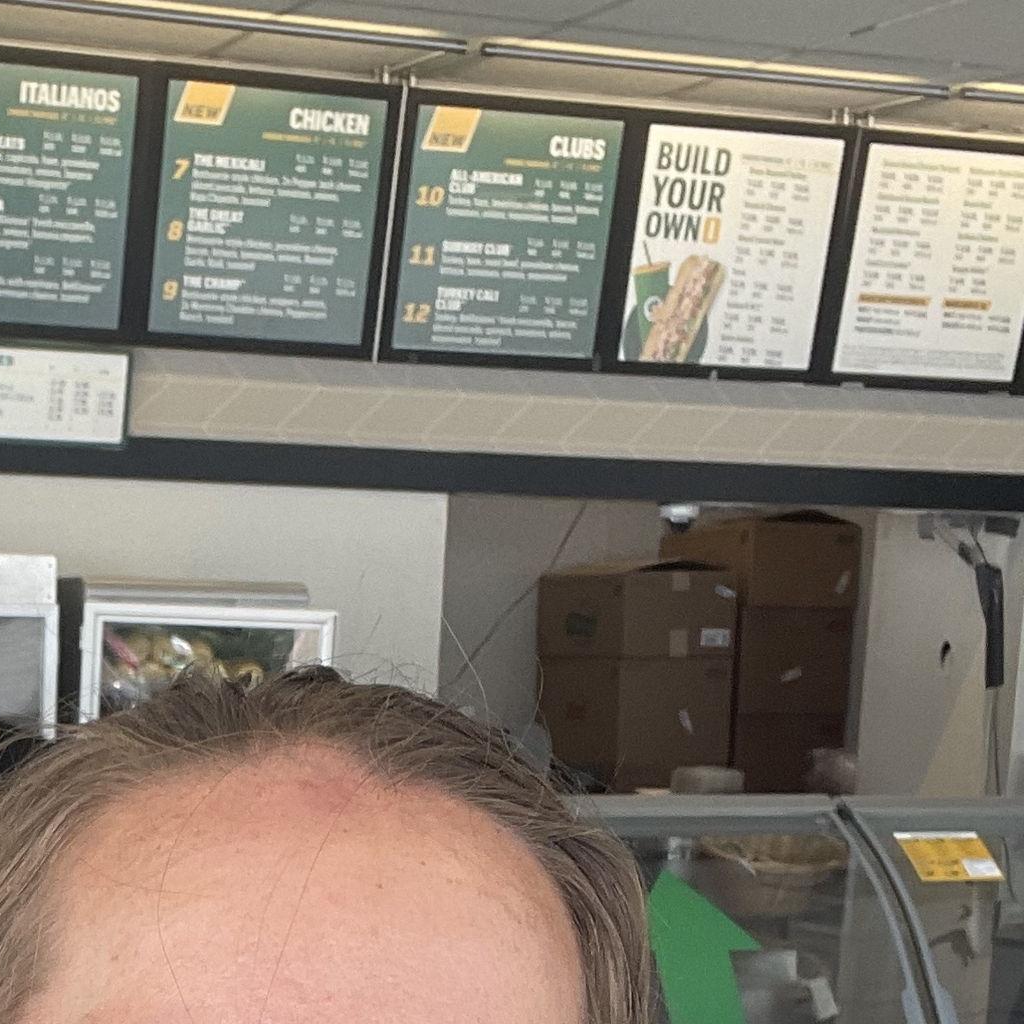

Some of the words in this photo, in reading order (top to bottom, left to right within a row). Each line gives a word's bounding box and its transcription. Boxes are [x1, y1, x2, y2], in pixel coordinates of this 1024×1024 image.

[19, 80, 121, 113] ITALIANOS
[182, 105, 221, 119] NEW
[289, 107, 372, 137] CHICKEN
[429, 132, 467, 147] NEW
[549, 134, 607, 161] CLUBS
[170, 157, 191, 181] 7
[656, 141, 732, 177] BUILD
[415, 184, 446, 208] 10
[653, 175, 726, 213] YOUR
[166, 219, 185, 242] 8
[645, 210, 702, 243] OWN
[408, 243, 436, 267] 11
[162, 279, 179, 302] 9
[401, 302, 432, 324] 12
